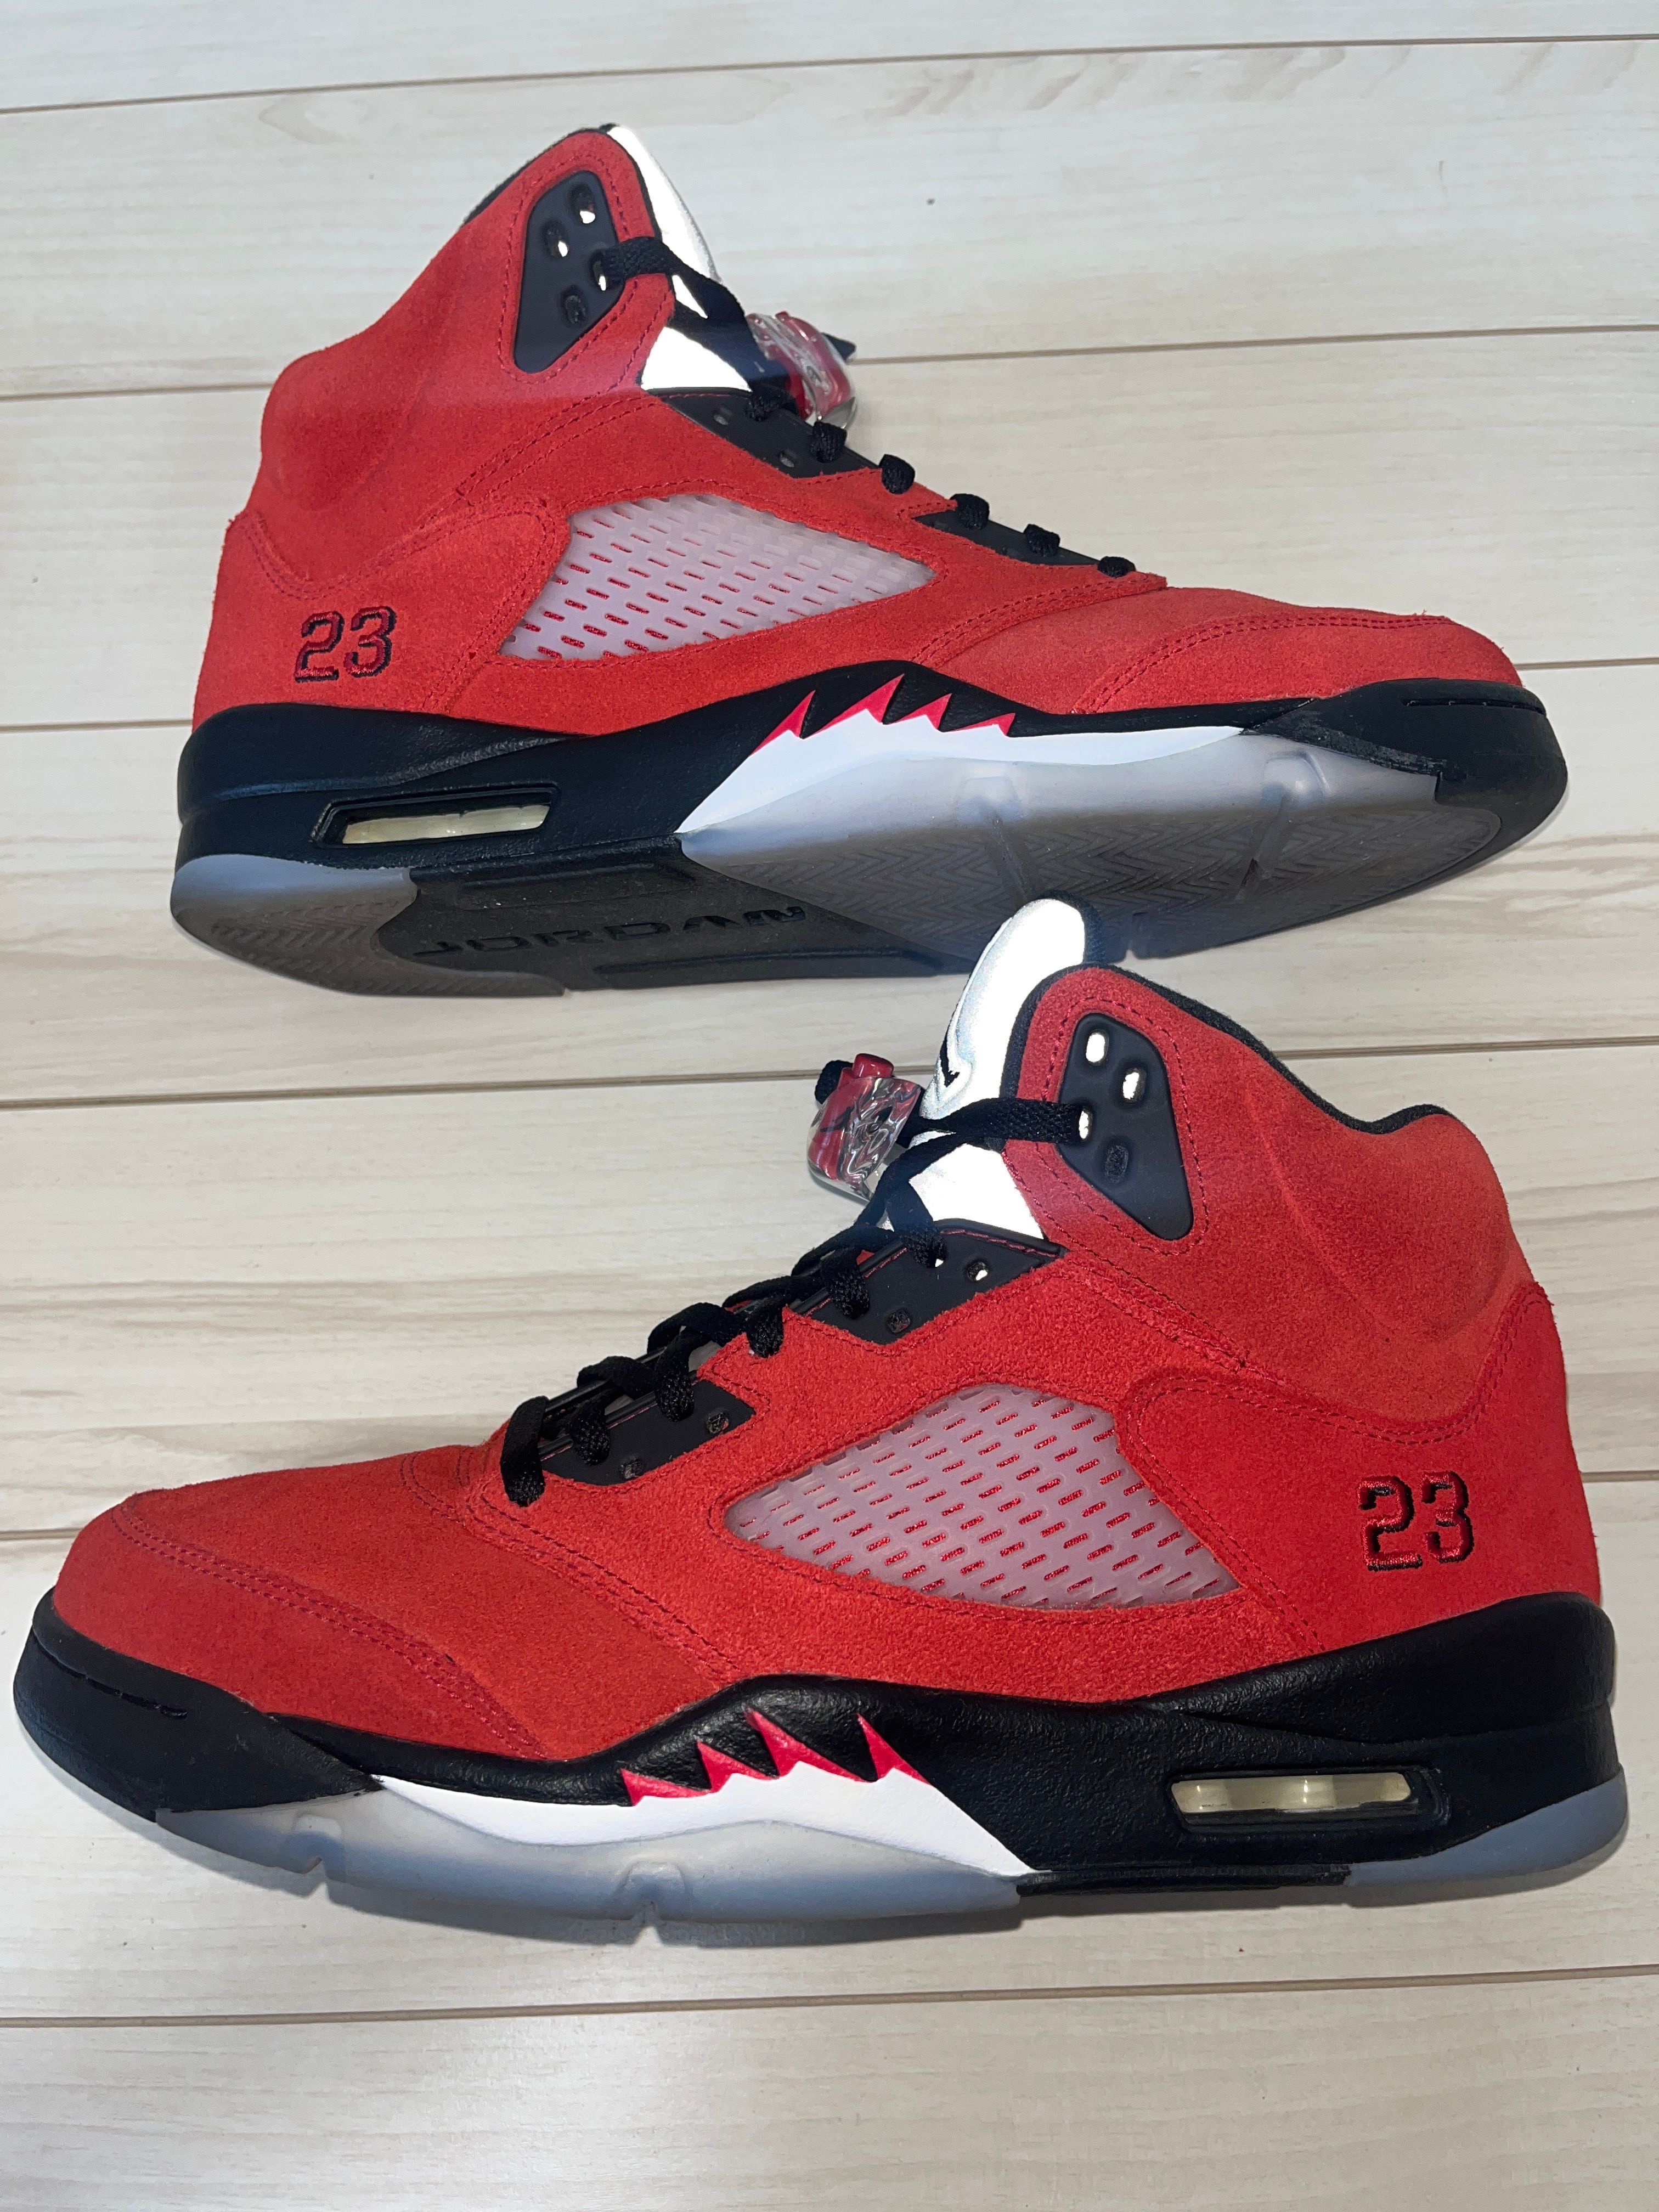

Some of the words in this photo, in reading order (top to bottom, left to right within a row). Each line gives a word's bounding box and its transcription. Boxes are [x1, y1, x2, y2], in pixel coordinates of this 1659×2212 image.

[294, 606, 397, 682] 23
[413, 906, 806, 956] JORDAN
[1357, 1470, 1474, 1571] 23
